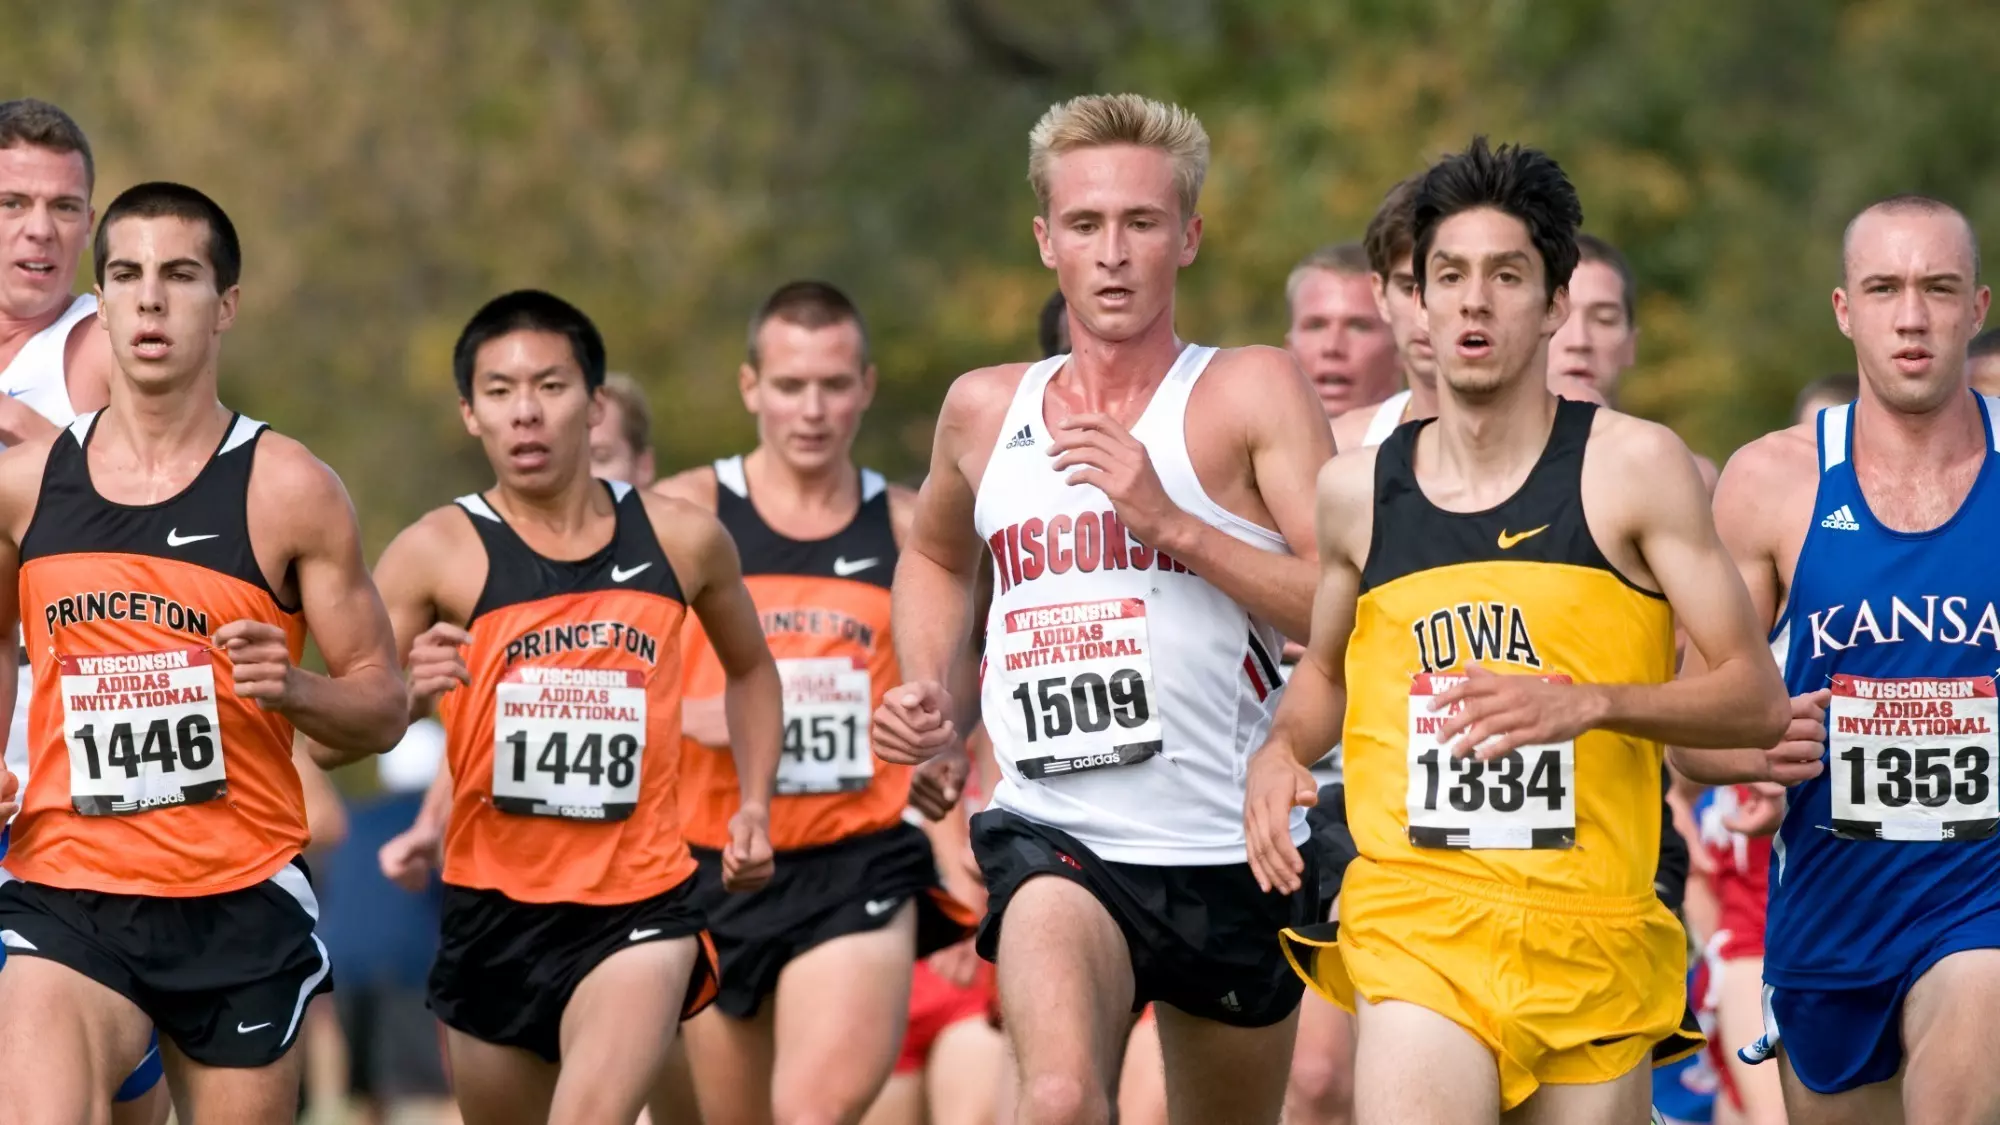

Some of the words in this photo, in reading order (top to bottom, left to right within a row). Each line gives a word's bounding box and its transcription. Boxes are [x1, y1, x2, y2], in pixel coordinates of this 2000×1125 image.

[1821, 519, 1859, 530] adidas
[989, 511, 1199, 596] WISCONS
[45, 590, 208, 638] PRINCETON
[1014, 601, 1122, 630] WISCONSIN
[1808, 595, 2000, 659] KANSA
[505, 621, 656, 667] PRINCETON
[763, 609, 874, 650] INCETON
[1032, 623, 1104, 648] ADIDAS
[1413, 602, 1541, 673] IOWA
[76, 651, 188, 676] WISCONSIN
[1005, 638, 1142, 671] INVITATIONAL
[96, 672, 171, 694] ADIDAS
[519, 667, 627, 689] WISCONSIN
[1852, 679, 1974, 699] WISCONSIN
[70, 685, 208, 712] INVITATIONAL
[539, 688, 609, 704] ADIDAS
[1013, 668, 1149, 742] 1509
[1873, 701, 1954, 719] ADIDAS
[504, 702, 639, 722] INVITATIONAL
[1838, 716, 1990, 737] INVITATIONAL
[74, 714, 214, 780] 1446
[783, 715, 857, 763] 451
[506, 730, 638, 789] 1448
[1073, 751, 1120, 769] adidas
[1417, 748, 1566, 812] 1334
[1841, 746, 1989, 808] 1353
[140, 791, 185, 808] adidas
